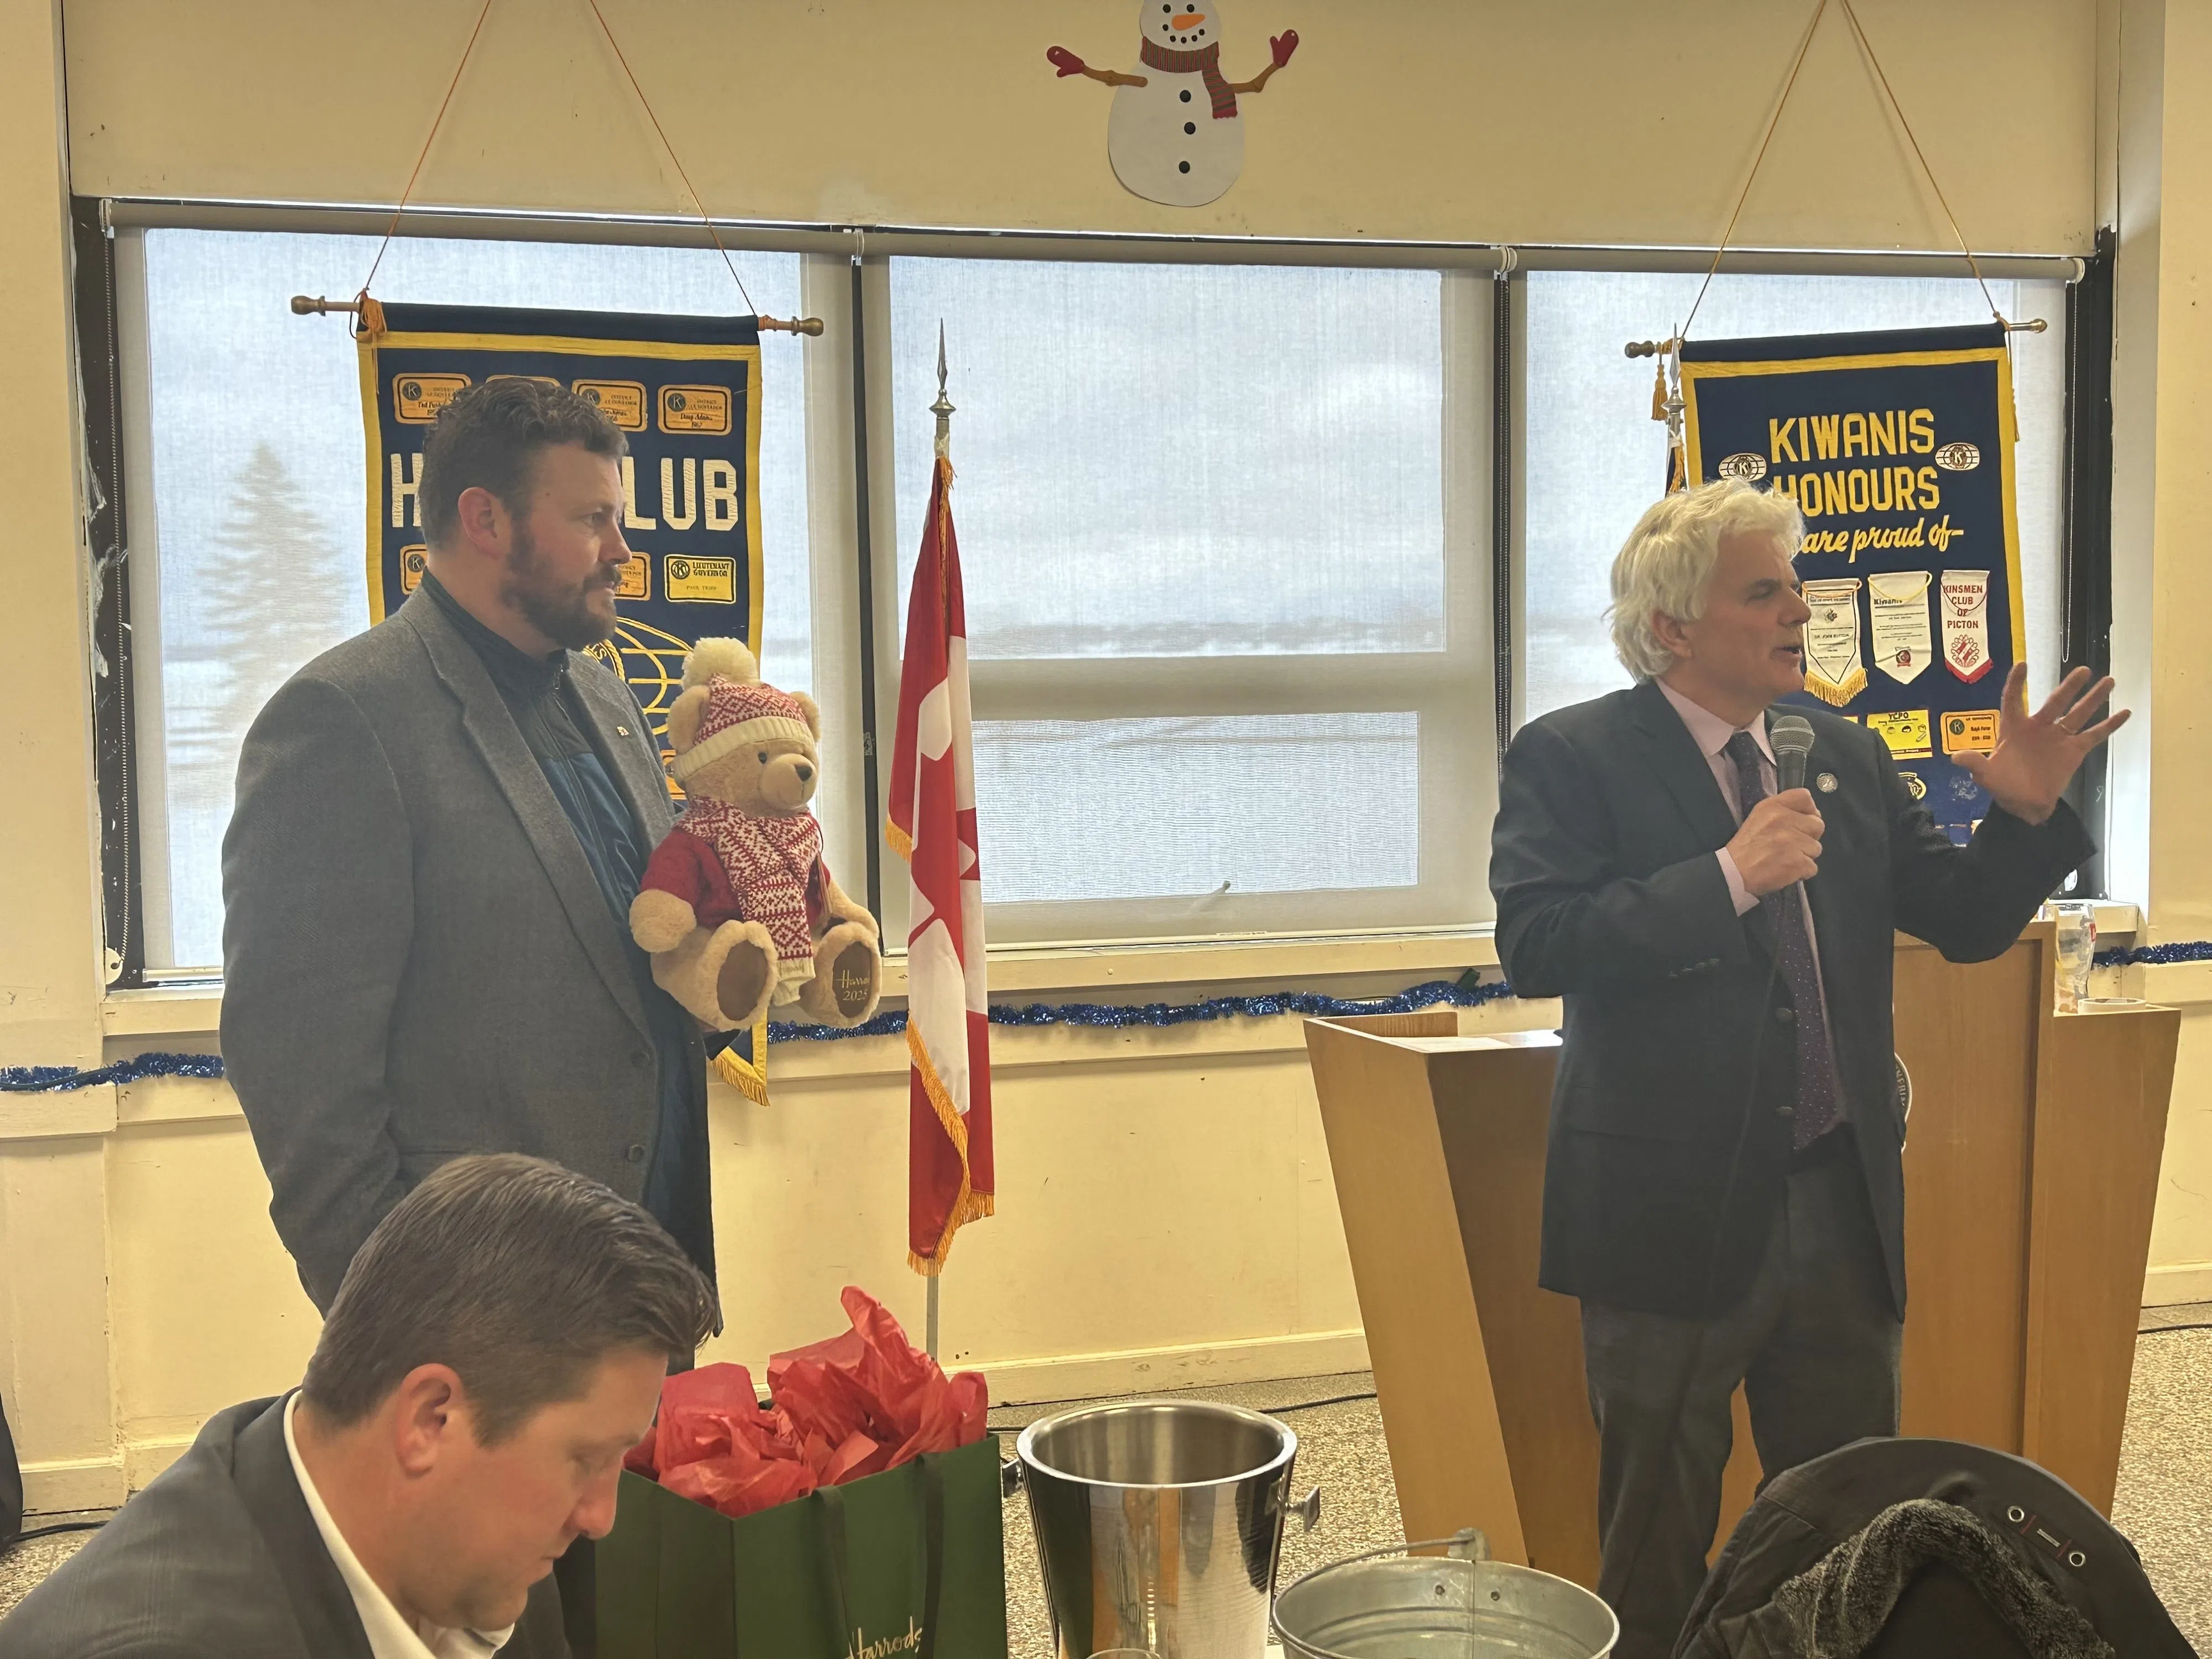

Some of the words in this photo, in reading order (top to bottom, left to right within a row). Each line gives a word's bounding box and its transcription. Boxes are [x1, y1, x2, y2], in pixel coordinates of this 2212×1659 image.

[1769, 408, 1935, 463] KIWANIS
[622, 456, 739, 531] LUB
[1801, 530, 1850, 554] are
[1848, 517, 1925, 564] proud
[1943, 585, 1983, 594] KINSMEN
[1952, 597, 1974, 605] CLUB
[1957, 608, 1968, 617] OF
[1947, 620, 1979, 629] PICTON
